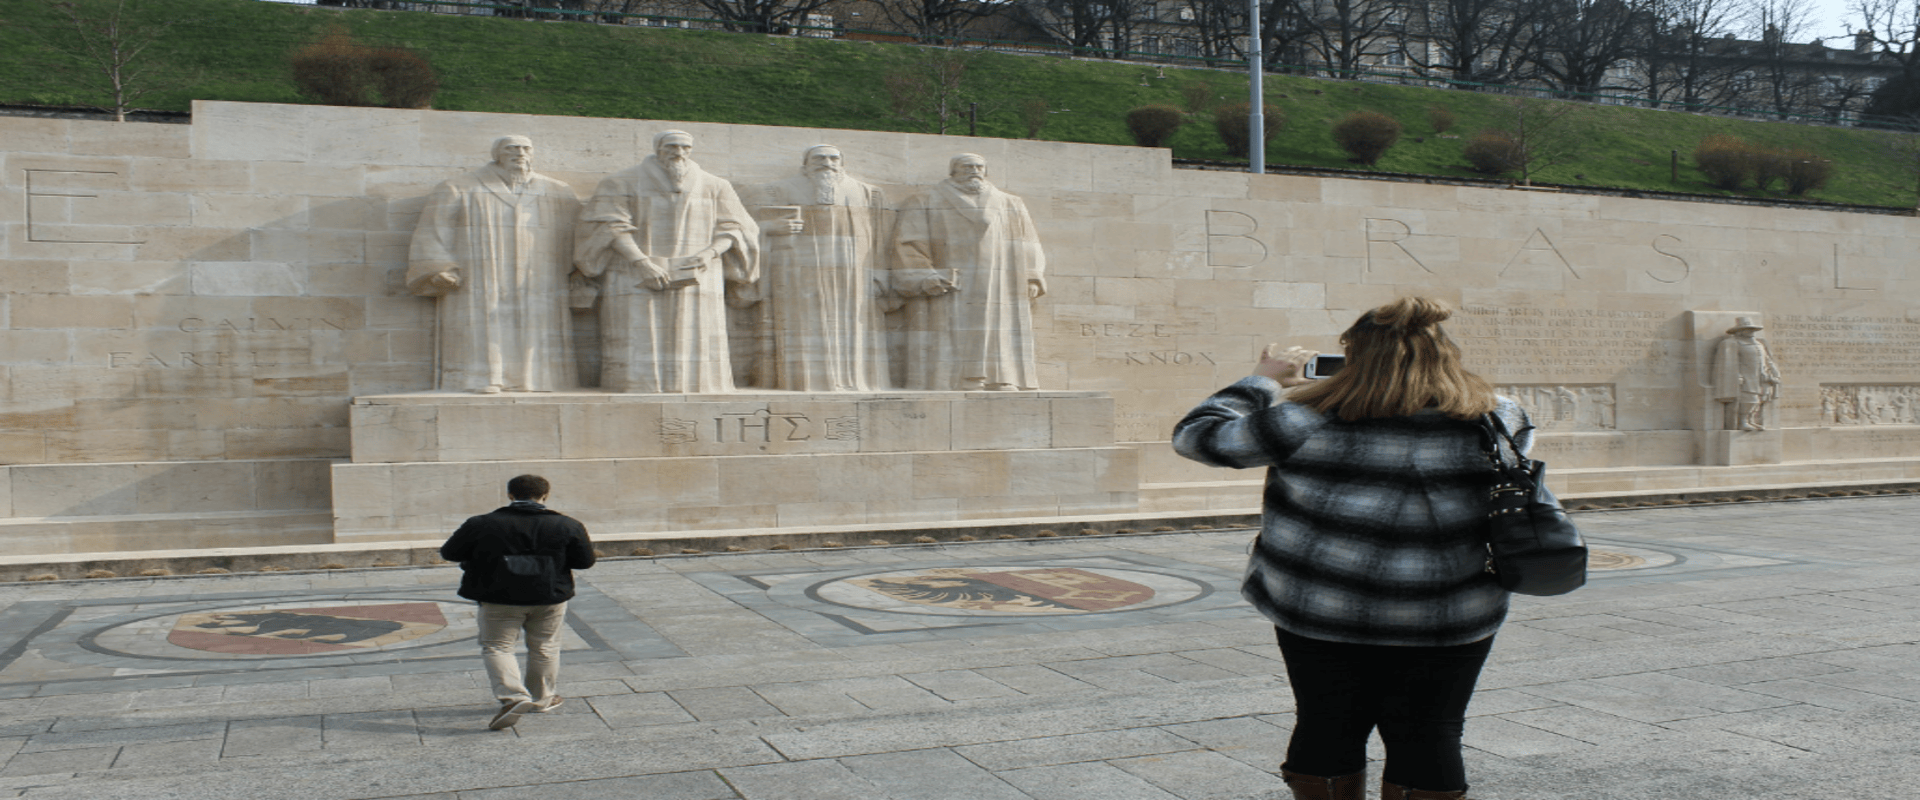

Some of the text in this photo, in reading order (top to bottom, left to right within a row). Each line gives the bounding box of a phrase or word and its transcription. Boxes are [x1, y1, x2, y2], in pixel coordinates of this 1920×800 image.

[24, 168, 146, 245] E
[1550, 308, 1592, 318] HEAVEN
[178, 316, 346, 333] CALVIN
[1080, 323, 1171, 338] BEZE
[1595, 330, 1639, 339] HEAVEN
[1514, 338, 1539, 347] FOR
[1543, 338, 1563, 347] THE
[1124, 351, 1217, 366] KNOX
[1497, 348, 1527, 357] EVEN
